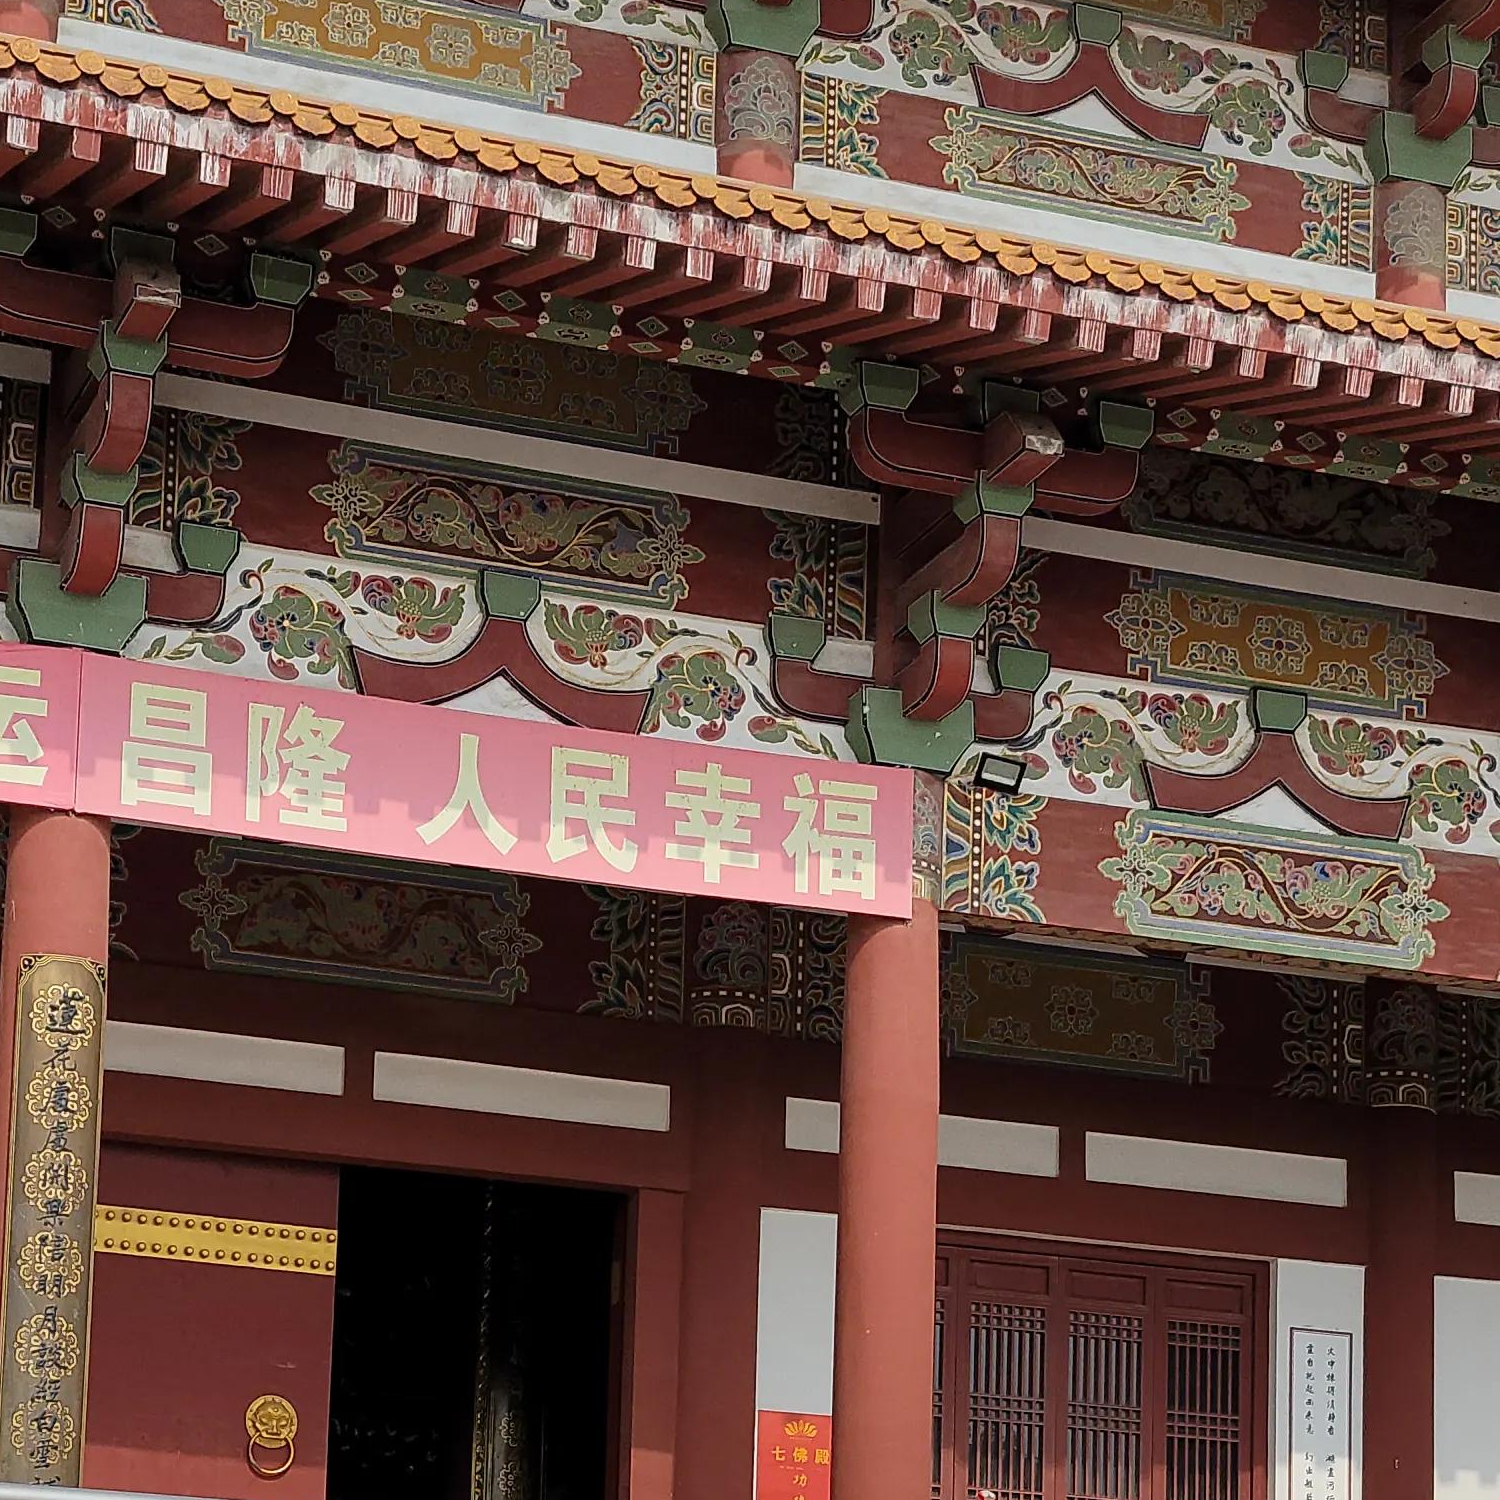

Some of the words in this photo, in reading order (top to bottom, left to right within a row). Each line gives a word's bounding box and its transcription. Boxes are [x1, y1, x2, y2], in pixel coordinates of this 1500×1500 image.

[416, 732, 878, 900] 人民幸福
[771, 1445, 830, 1465] 七佛殿
